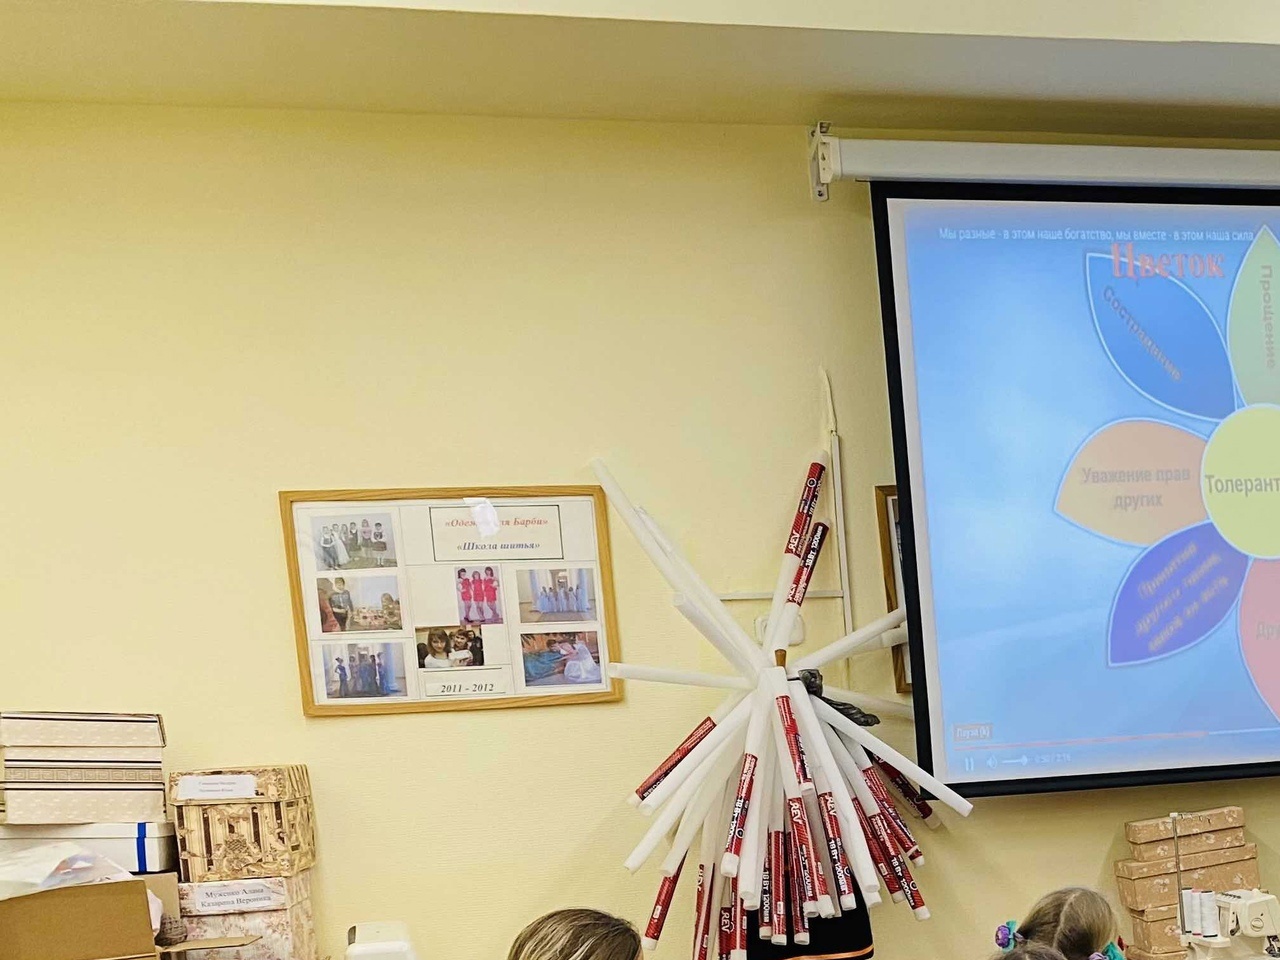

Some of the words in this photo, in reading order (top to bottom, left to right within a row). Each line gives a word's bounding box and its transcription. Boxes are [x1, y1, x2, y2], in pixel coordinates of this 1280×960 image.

[939, 227, 956, 240] Мы
[958, 229, 996, 242] разные
[1011, 231, 1035, 240] этом
[1037, 231, 1062, 240] наше
[1064, 227, 1114, 242] богатство,
[1116, 231, 1131, 240] мы
[1133, 231, 1166, 240] вместе
[1181, 231, 1203, 240] этом
[1205, 231, 1230, 240] наша
[1231, 231, 1254, 241] сила
[1110, 242, 1226, 284] Цветок
[1082, 468, 1150, 484] Уважение
[1156, 467, 1191, 484] прав
[1113, 494, 1163, 511] других
[457, 541, 497, 551] «Школа
[500, 542, 540, 550] шитья»
[441, 684, 462, 693] 2011
[472, 683, 494, 692] 2012
[721, 910, 730, 933] REV
